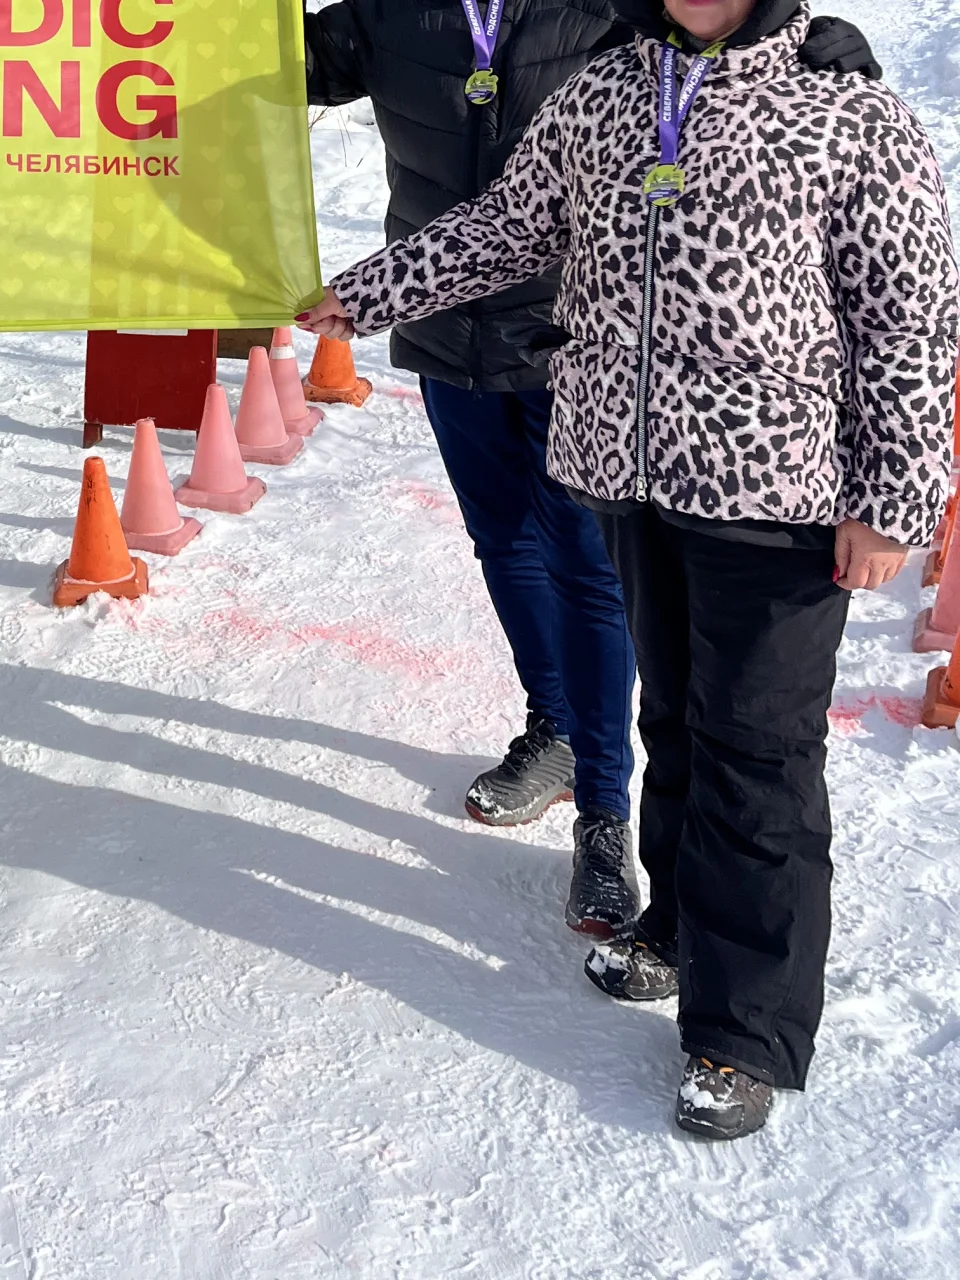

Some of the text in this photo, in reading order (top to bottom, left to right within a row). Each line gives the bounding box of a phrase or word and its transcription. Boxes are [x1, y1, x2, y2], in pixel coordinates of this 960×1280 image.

[465, 0, 481, 35] СЕВЕРНАЯ
[663, 78, 672, 122] СЕВЕРНАЯ
[5, 153, 181, 178] ЧЕЛЯБИНСК
